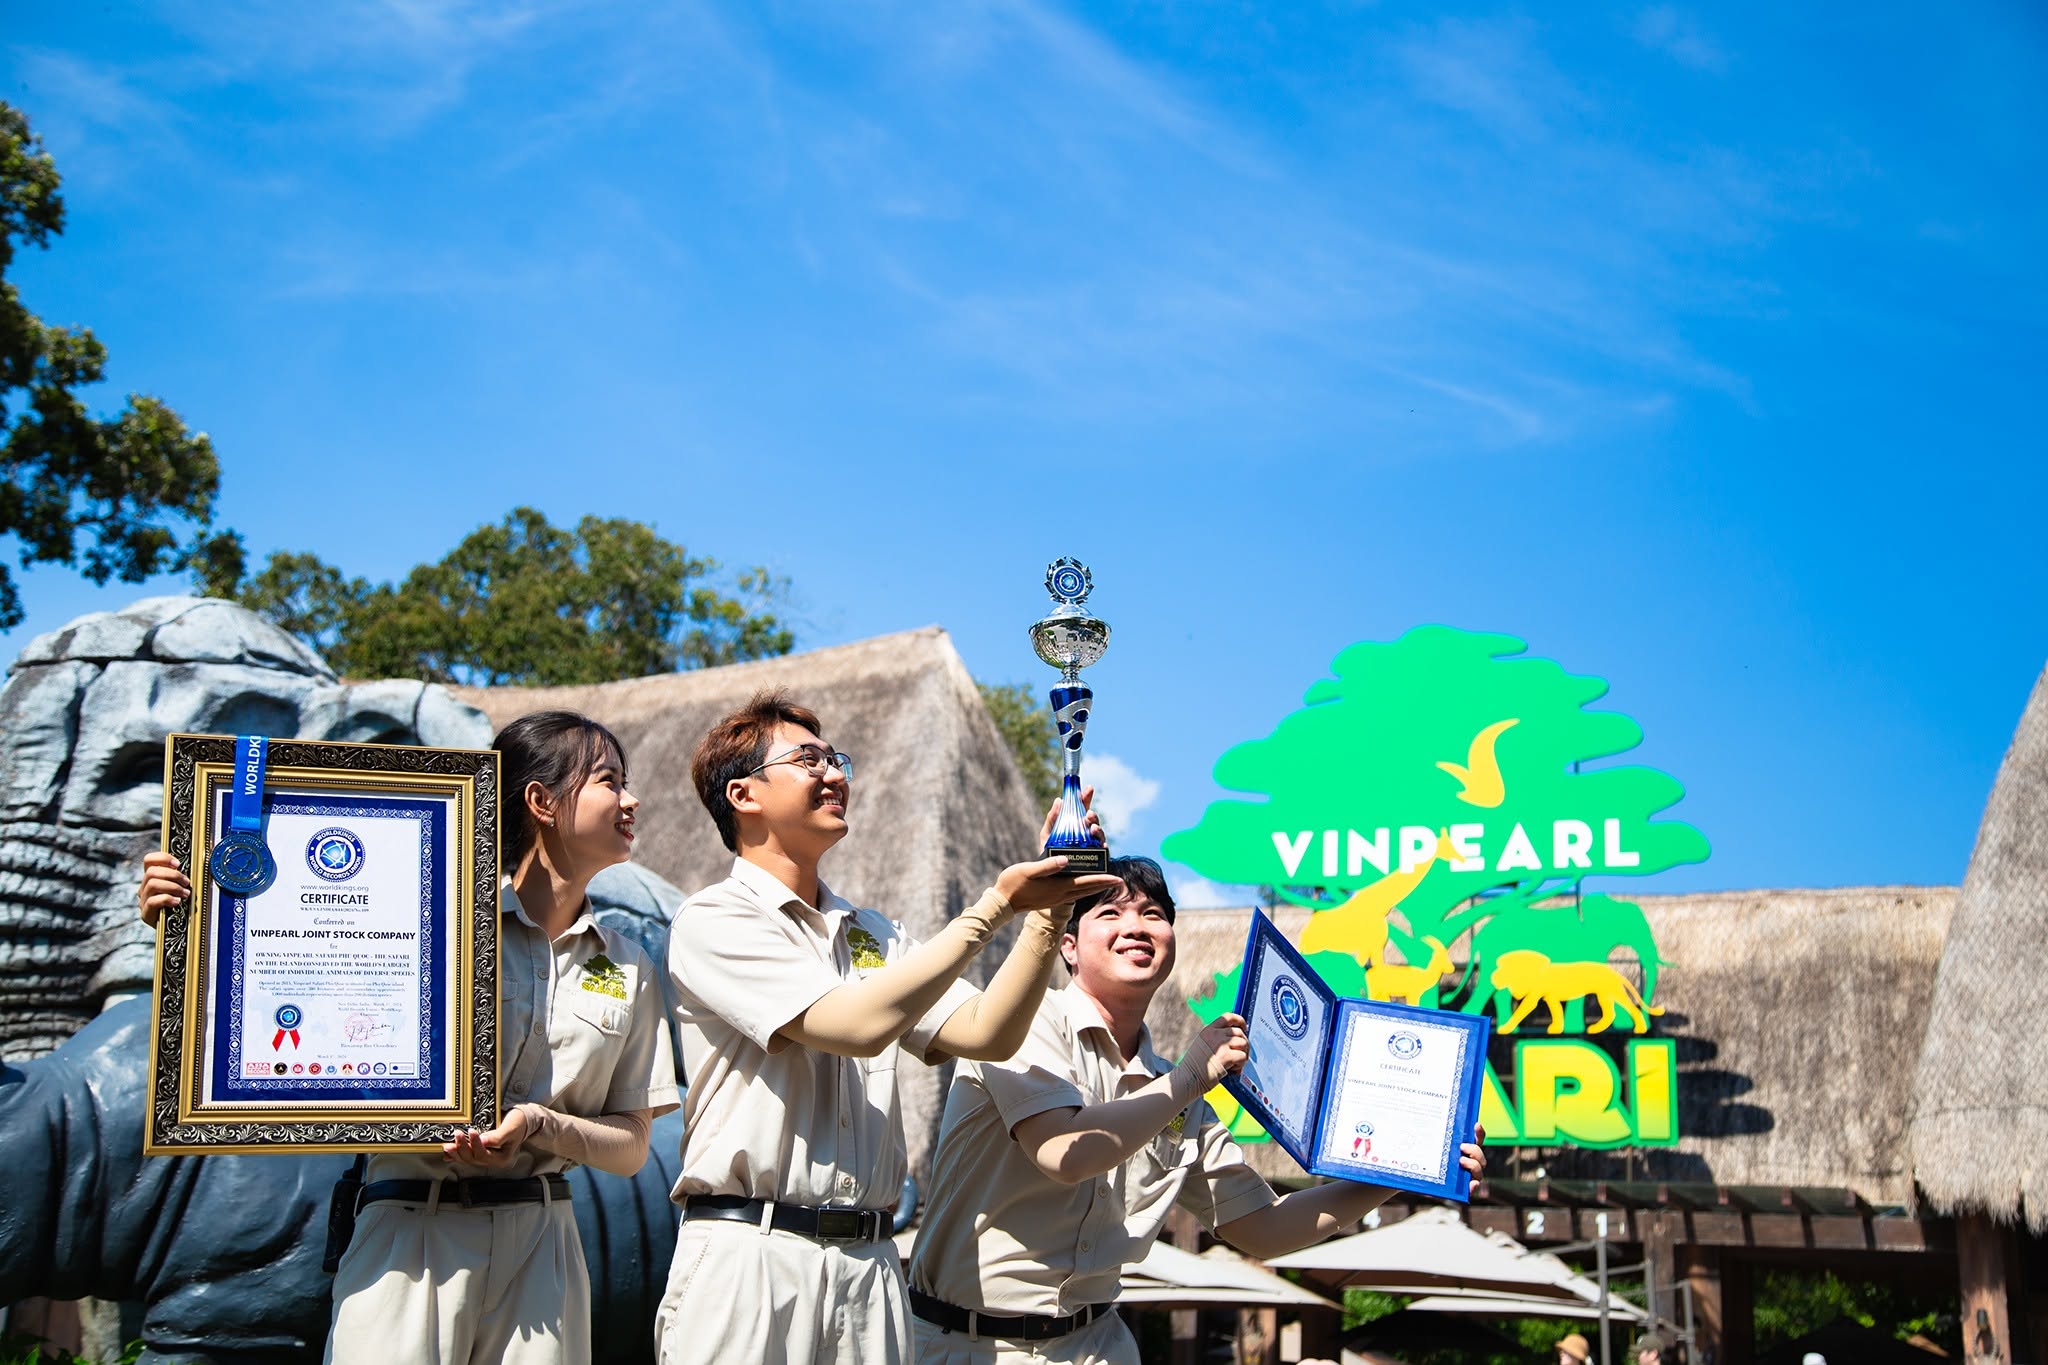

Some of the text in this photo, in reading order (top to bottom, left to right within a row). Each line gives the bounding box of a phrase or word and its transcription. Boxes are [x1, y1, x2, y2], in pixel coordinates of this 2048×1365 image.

[1271, 818, 1640, 878] VINPEARL
[300, 893, 369, 905] CERTIFICATE
[313, 917, 344, 926] Conferred
[250, 929, 416, 940] VINPEARL JOINT STOCK COMPANY
[1380, 1063, 1421, 1075] CERTIFICATE
[1527, 1211, 1545, 1234] 2
[1594, 1212, 1608, 1237] 1
